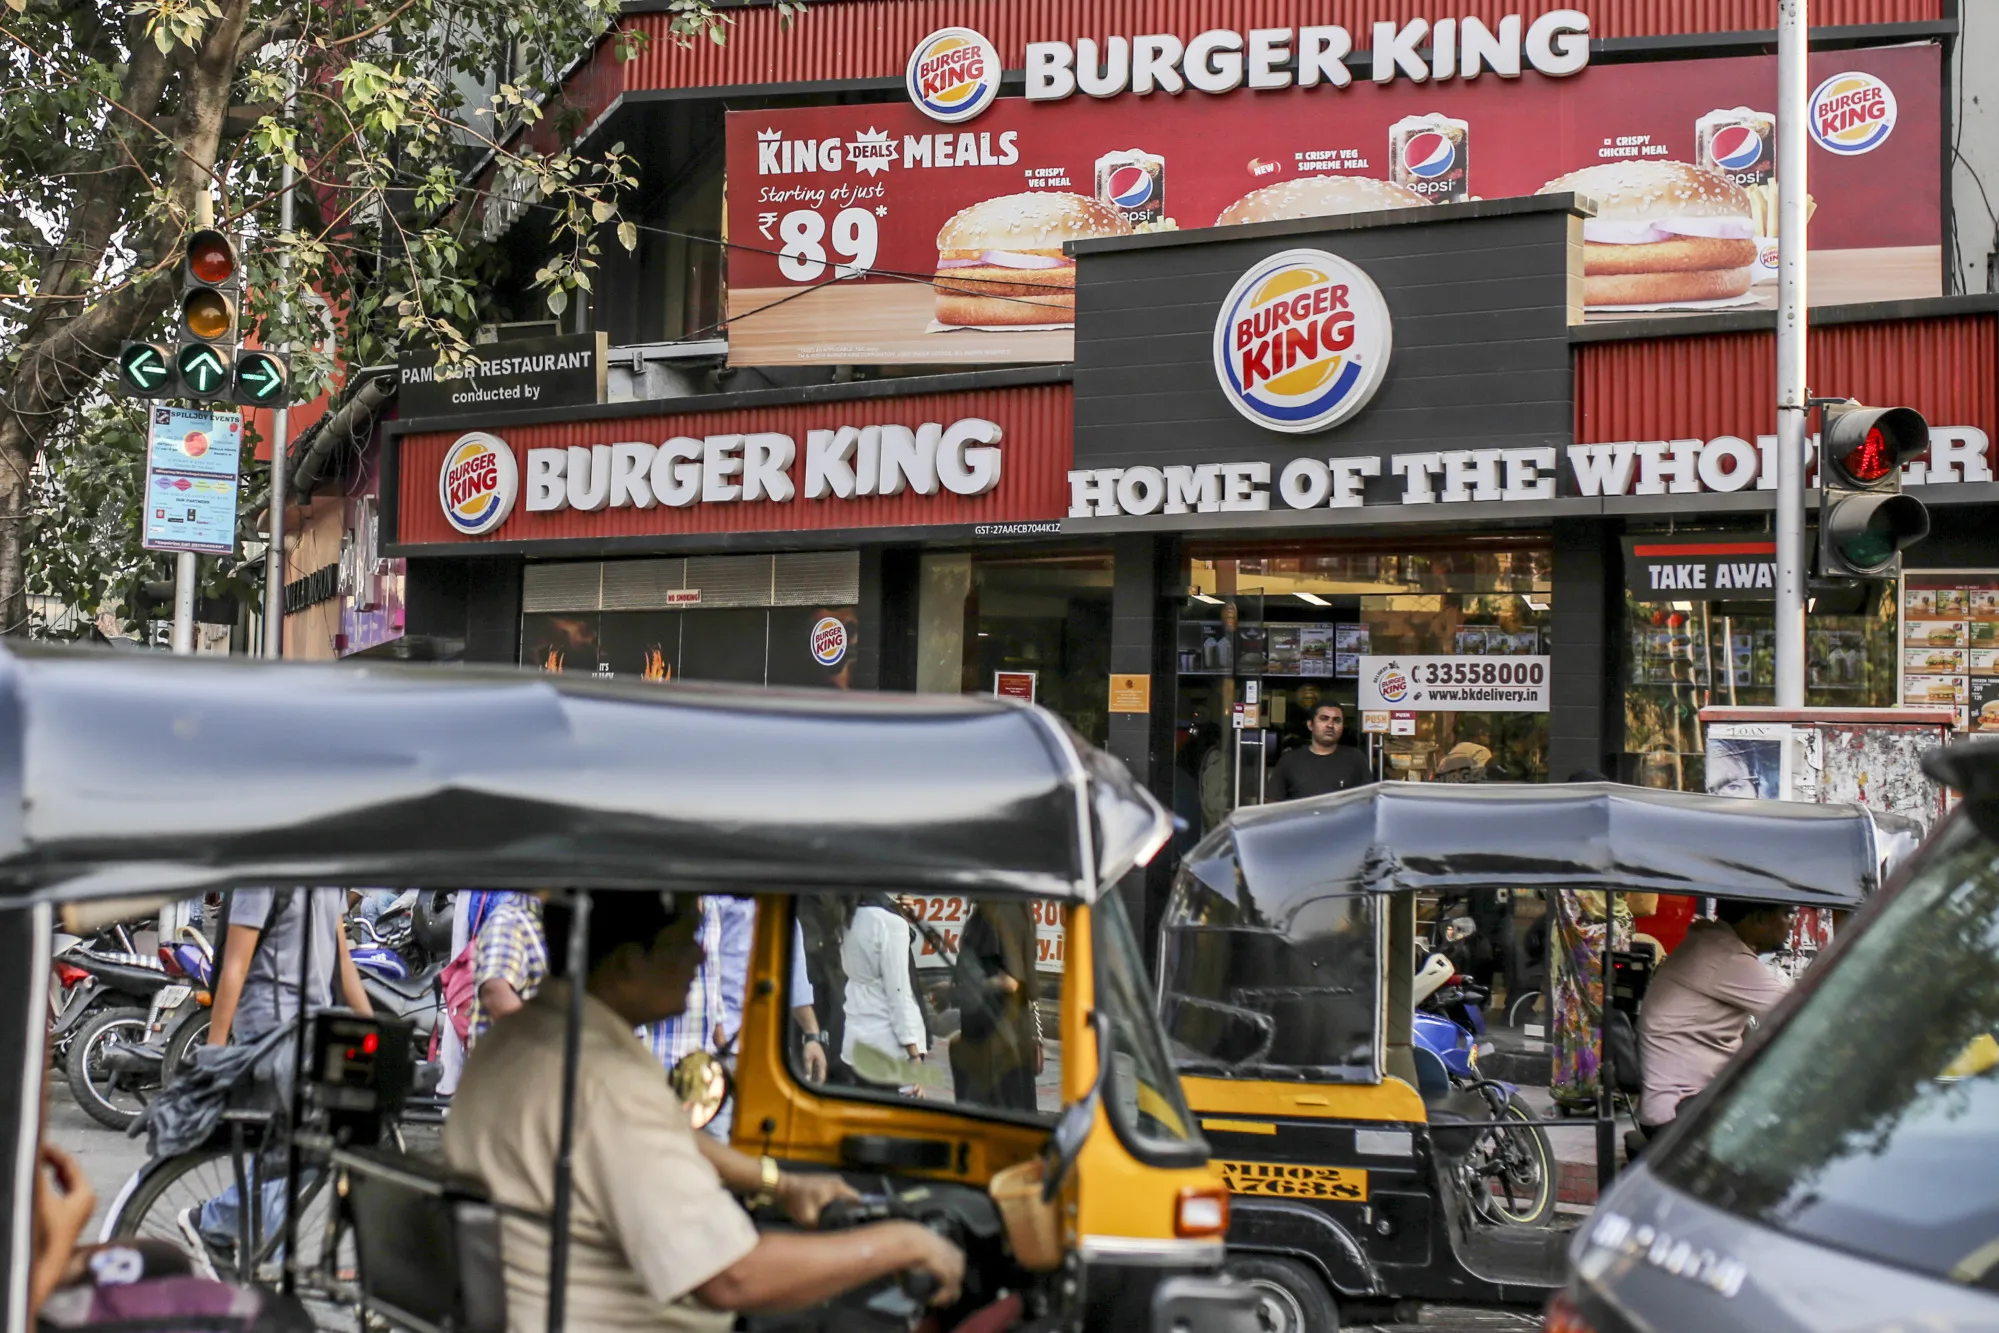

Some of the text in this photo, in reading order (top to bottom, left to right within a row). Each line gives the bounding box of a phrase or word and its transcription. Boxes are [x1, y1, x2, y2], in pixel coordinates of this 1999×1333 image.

[920, 46, 981, 79] BURGER
[1025, 9, 1590, 101] BURGER KING
[923, 59, 984, 101] KING
[1818, 87, 1882, 119] BURGER
[1821, 100, 1885, 138] KING
[1616, 135, 1651, 147] CRISPY
[758, 131, 1019, 175] KING DEALS MEALS
[1305, 149, 1358, 160] CRISPY VEG
[1598, 145, 1668, 158] CHICKEN MEAL
[1035, 168, 1065, 178] CRISPY
[1254, 164, 1274, 176] NEW
[1298, 159, 1369, 171] SUPREME MEAL
[1028, 177, 1071, 188] VEG MEAL
[1725, 170, 1760, 187] epsi
[758, 181, 884, 209] Starting at just
[1120, 208, 1150, 224] epsi
[1763, 255, 1780, 264] KIN
[1237, 284, 1349, 351] BURGER
[1242, 311, 1355, 391] KING
[481, 351, 592, 376] RESTAURANT
[452, 384, 540, 403] conducted by
[210, 414, 240, 423] EVENTS
[449, 453, 496, 486] BURGER
[526, 418, 1003, 512] BURGER KING
[450, 468, 498, 510] KING
[1067, 461, 1272, 518] HOME
[1279, 456, 1381, 510] OF
[1392, 447, 1557, 504] THE
[1648, 564, 1706, 590] TAKE
[676, 594, 698, 602] SMOKING
[815, 625, 842, 644] BURGER
[816, 634, 843, 654] KING
[1381, 675, 1406, 689] BURGER
[1425, 662, 1544, 684] 33558000
[1382, 682, 1407, 696] KING
[1428, 688, 1538, 702] www.bkdelivery.in
[1365, 714, 1388, 724] PUSH
[1224, 1163, 1341, 1182] MH02
